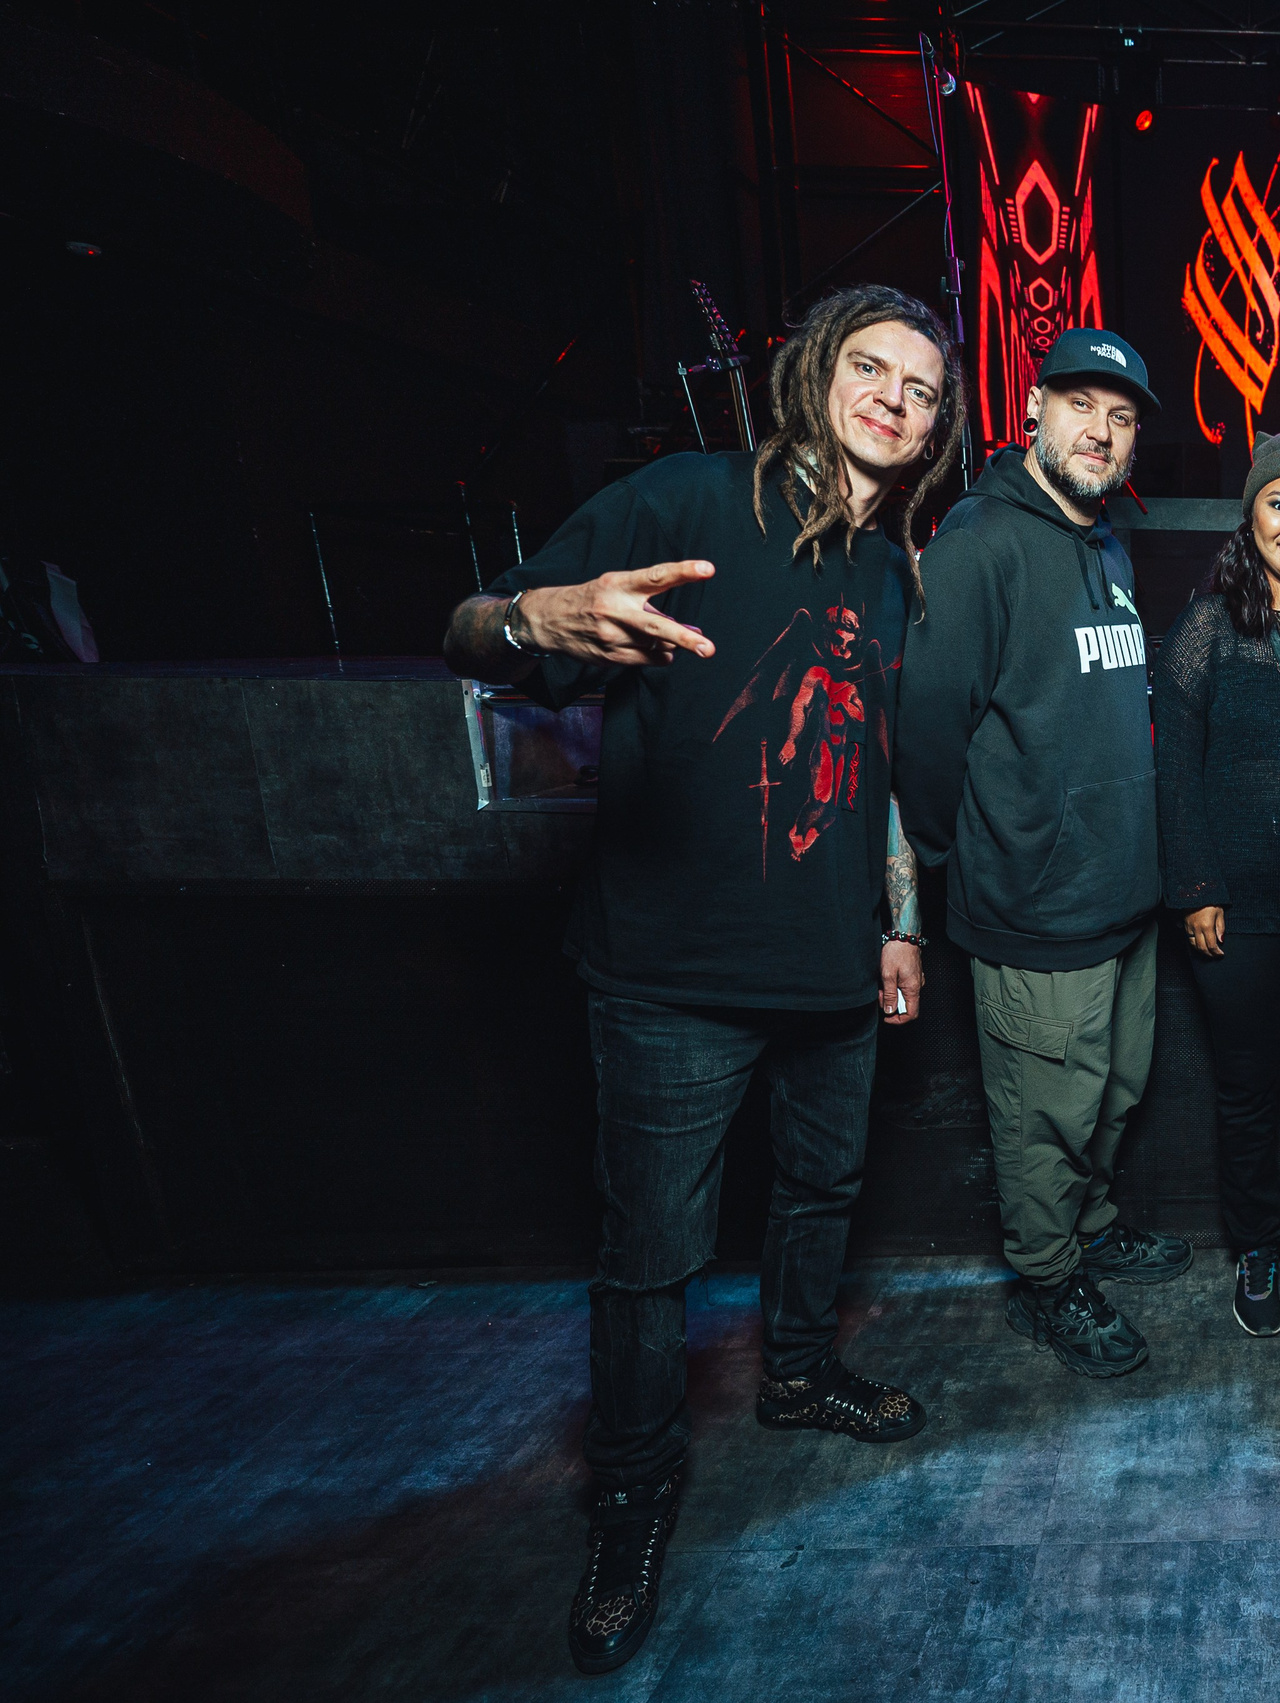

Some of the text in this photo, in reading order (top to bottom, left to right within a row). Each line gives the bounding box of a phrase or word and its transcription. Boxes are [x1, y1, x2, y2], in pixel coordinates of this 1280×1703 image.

[1090, 345, 1116, 356] NORTH
[1097, 350, 1116, 361] FACE
[1074, 623, 1146, 674] PUMA
